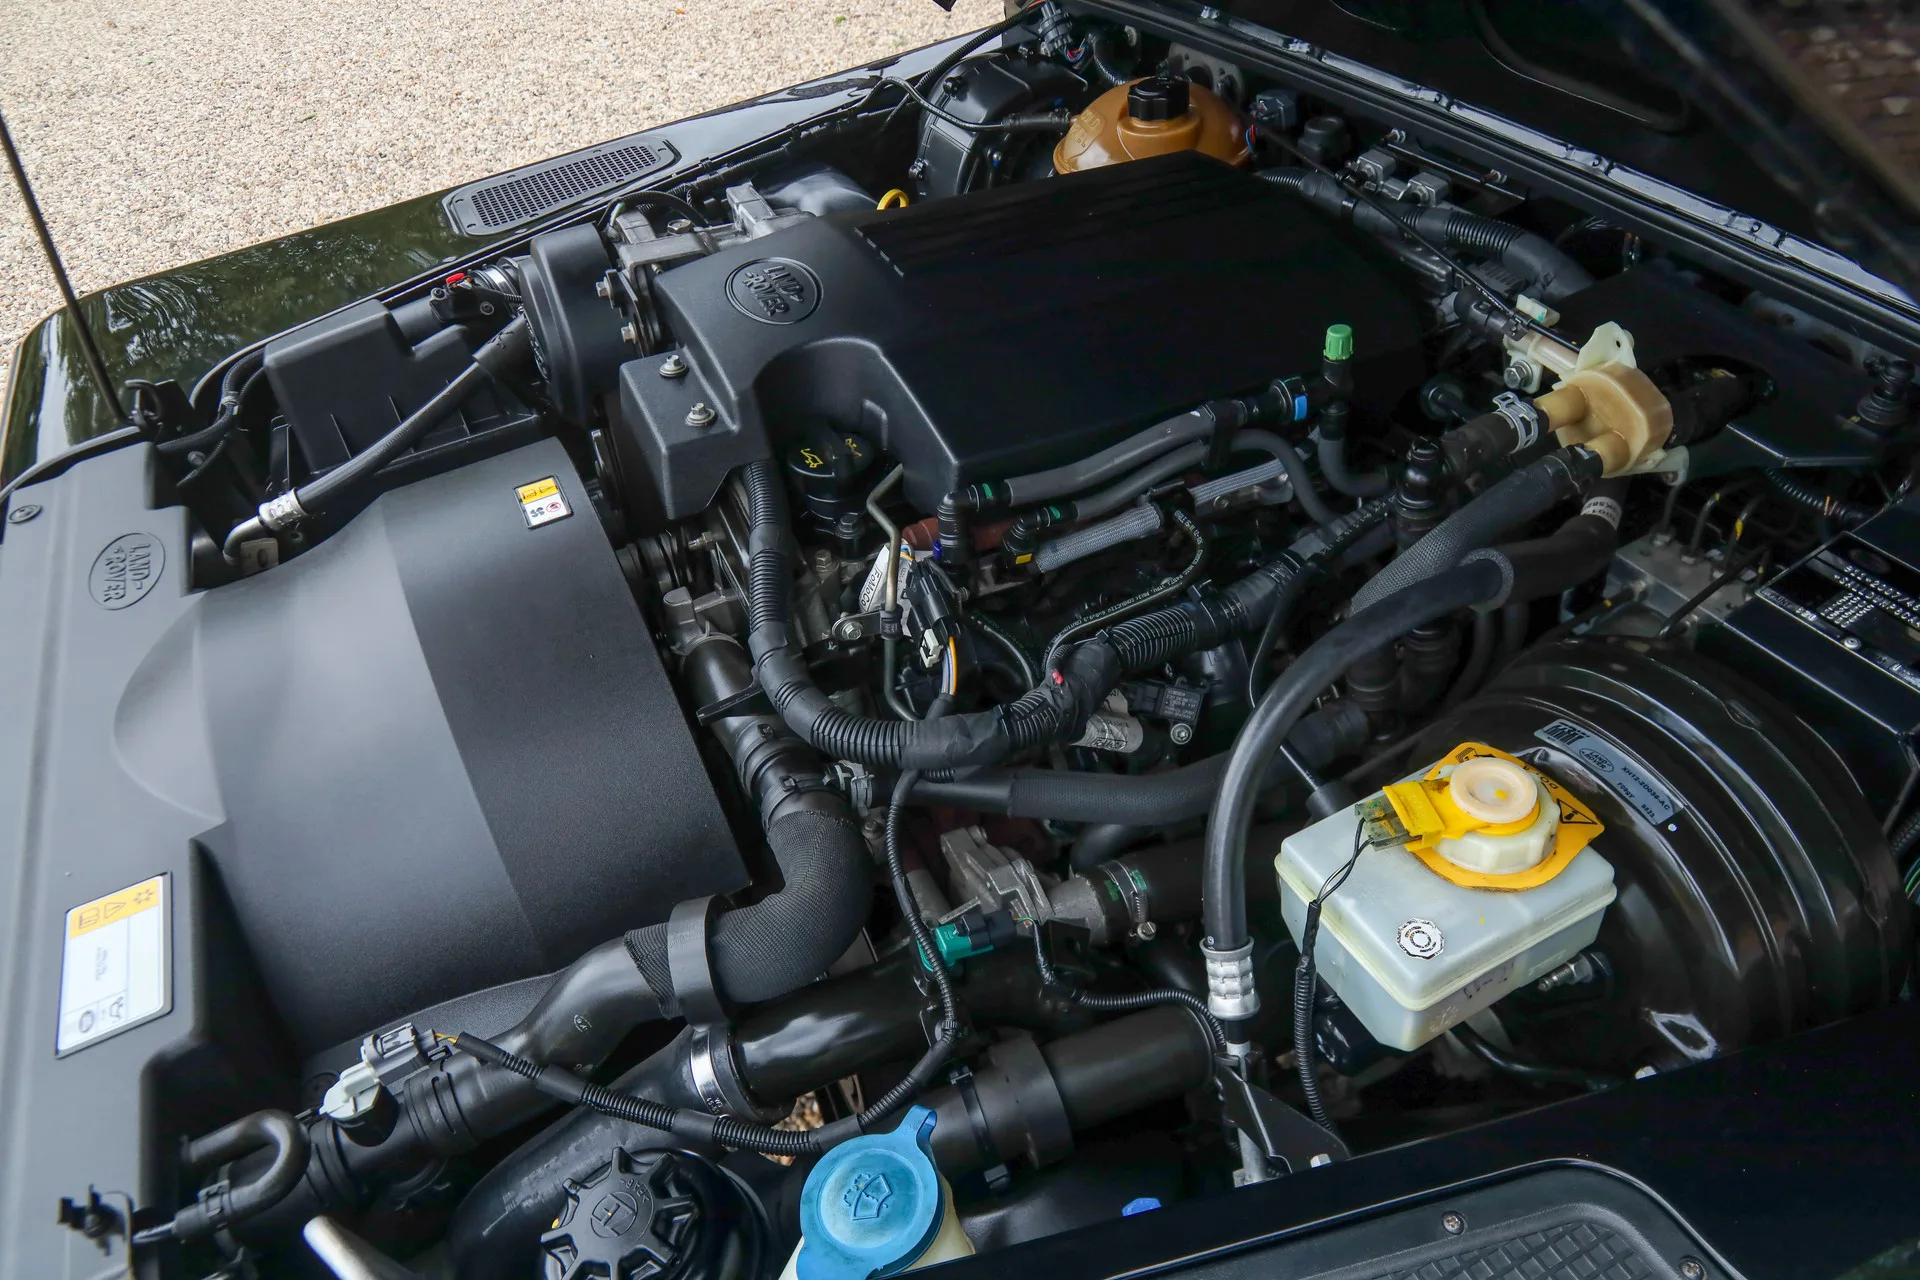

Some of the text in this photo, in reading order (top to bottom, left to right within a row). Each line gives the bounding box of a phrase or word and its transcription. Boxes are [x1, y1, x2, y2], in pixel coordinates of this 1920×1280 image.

[743, 274, 790, 316] ROVER
[763, 265, 803, 295] LAND
[103, 552, 127, 603] ROVER
[128, 543, 151, 582] LAND
[1584, 753, 1606, 769] ROVER
[1589, 751, 1608, 764] LAND
